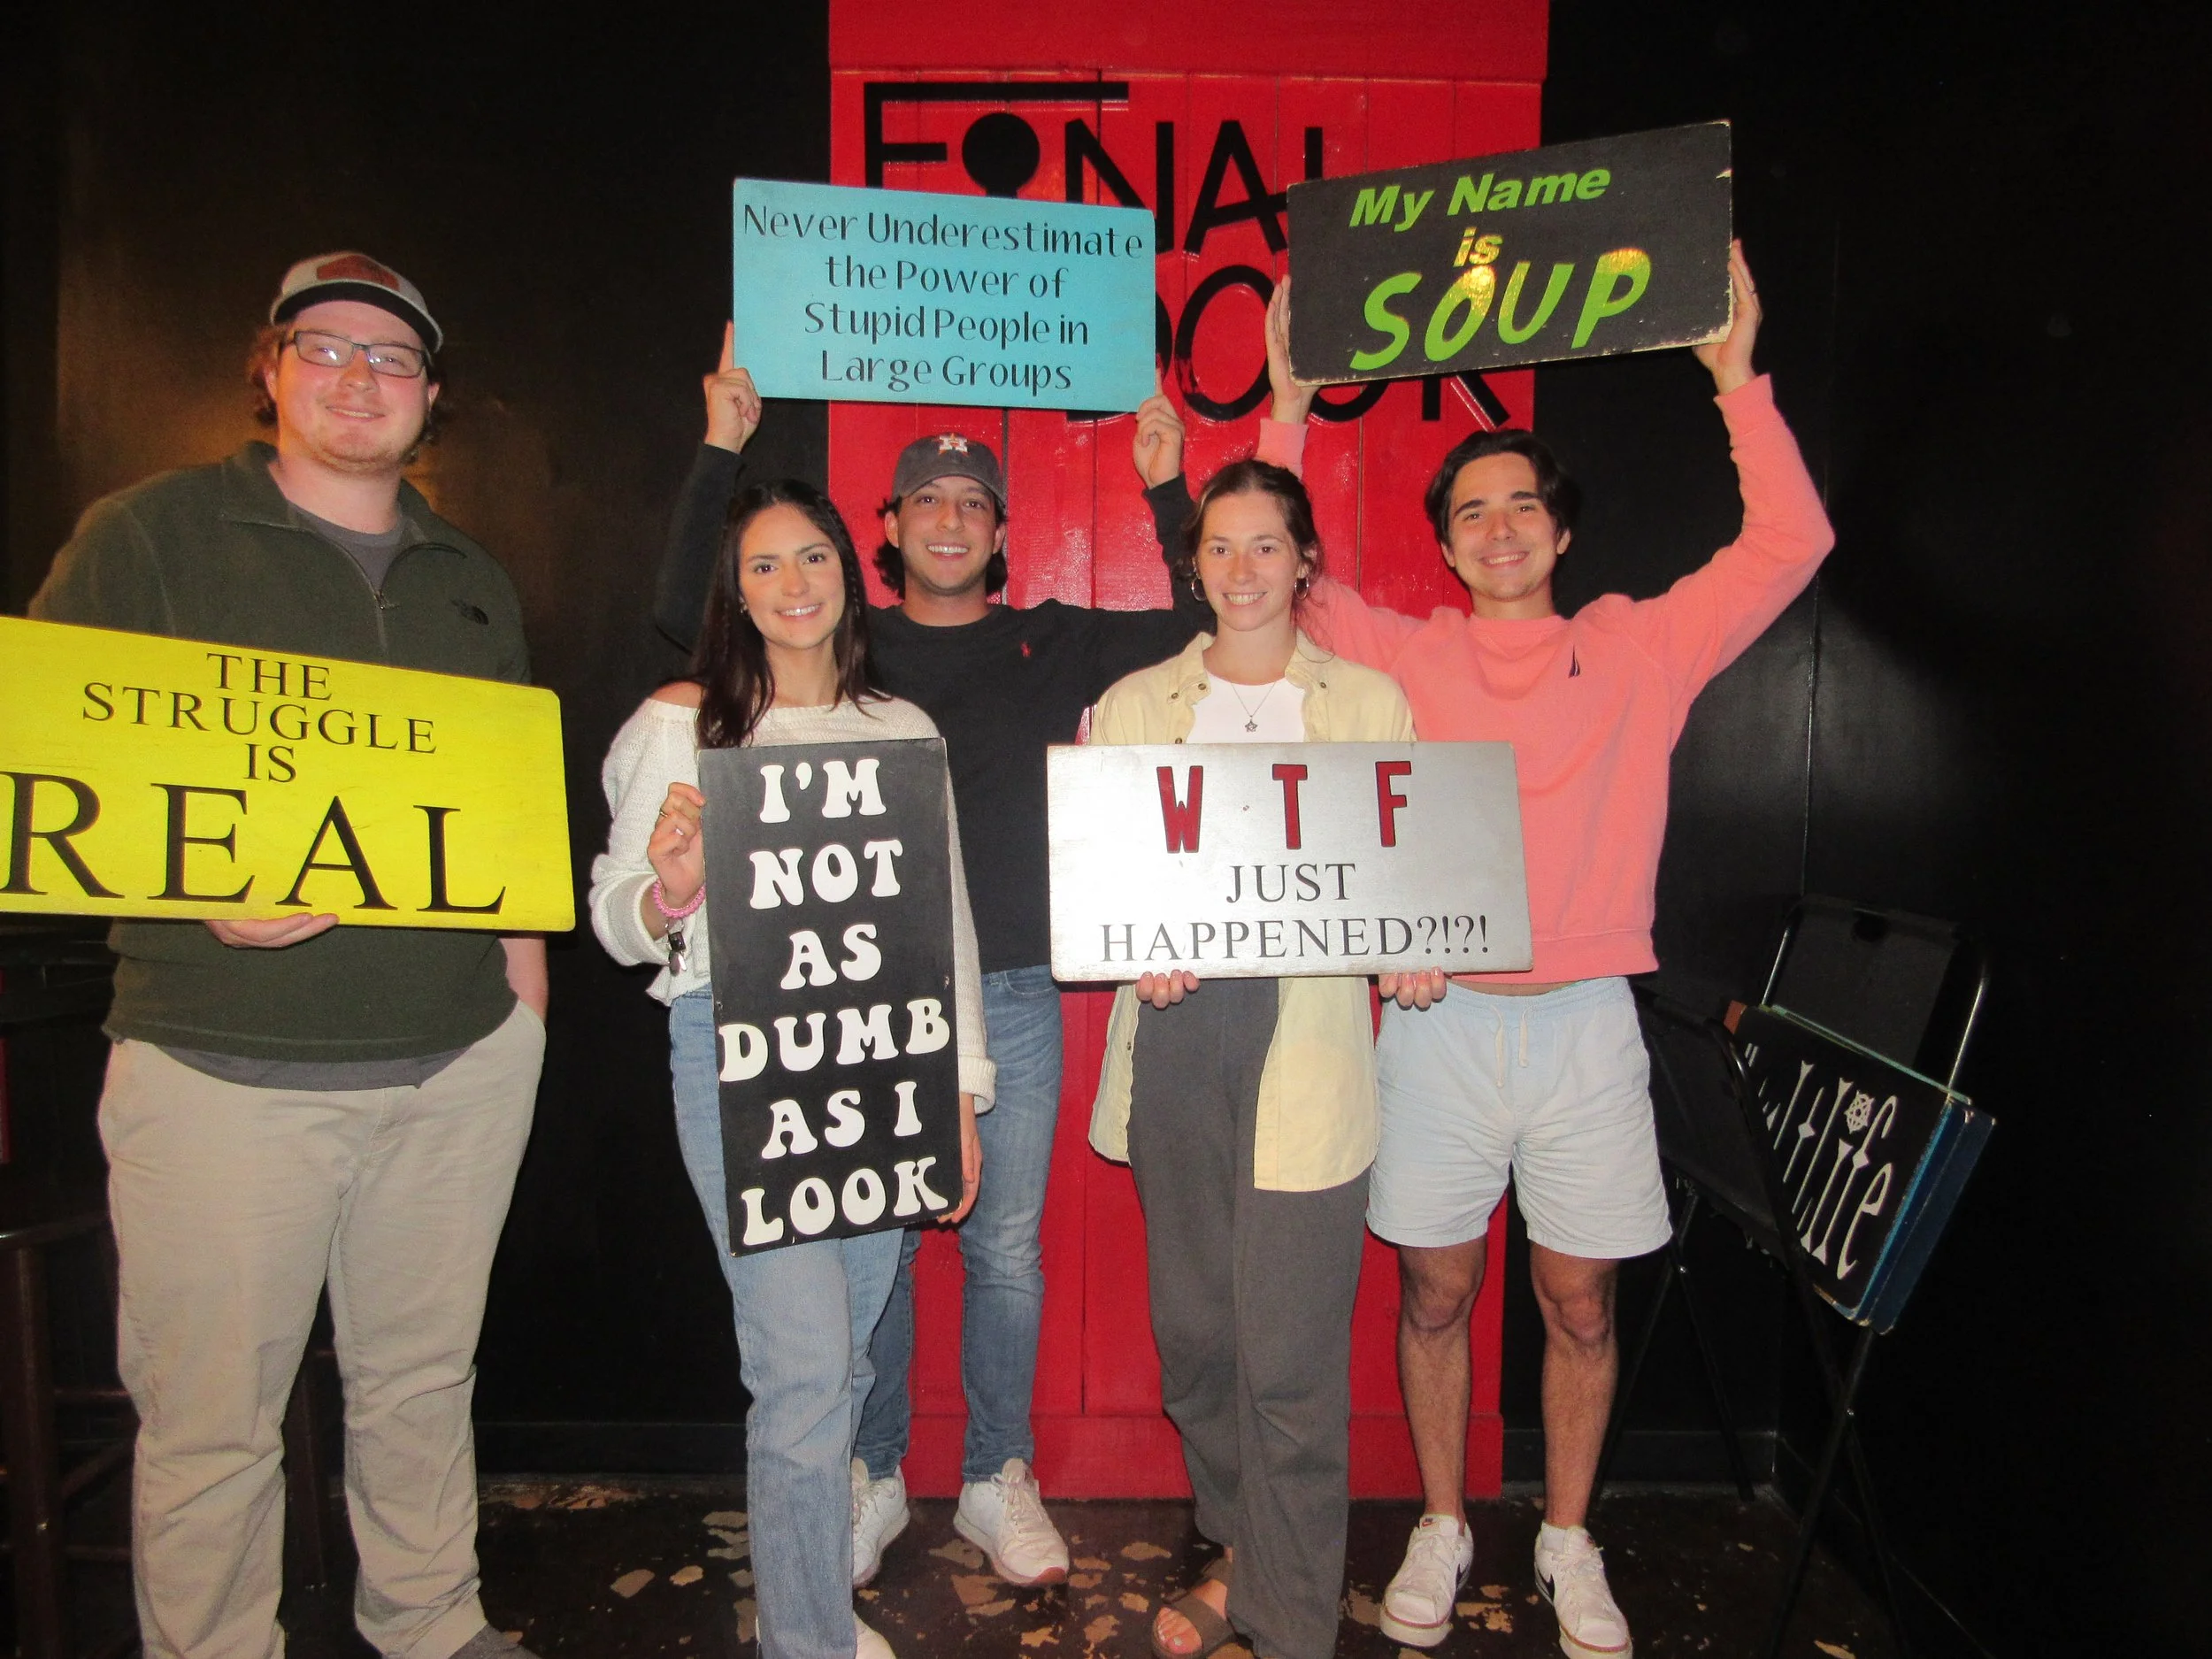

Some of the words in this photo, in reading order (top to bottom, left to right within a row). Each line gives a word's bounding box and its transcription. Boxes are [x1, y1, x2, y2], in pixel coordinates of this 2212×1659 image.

[744, 204, 858, 241] Never
[868, 211, 1144, 258] Underestimate
[1349, 184, 1435, 234] My
[1447, 168, 1611, 218] Name
[825, 255, 887, 289] the
[896, 260, 1020, 296] Power
[1028, 267, 1069, 299] of
[1453, 227, 1504, 268] is
[804, 302, 925, 345] Stupid
[933, 308, 1051, 351] People
[1059, 314, 1089, 346] in
[1349, 248, 1652, 372] SOUP
[822, 349, 933, 393] Large
[941, 355, 1072, 397] Groups
[206, 652, 333, 702] THE
[82, 682, 438, 754] STRUGGLE
[246, 743, 297, 783] IS
[759, 758, 887, 824] I'M
[0, 770, 507, 916] REAL
[749, 839, 903, 910] NOT
[1225, 863, 1357, 903] JUST
[780, 924, 883, 990] AS
[1100, 914, 1490, 963] HAPPENED?!?!
[718, 998, 951, 1082] DUMB
[761, 1089, 866, 1160] AS
[893, 1080, 923, 1138] I
[741, 1156, 949, 1246] LOOK
